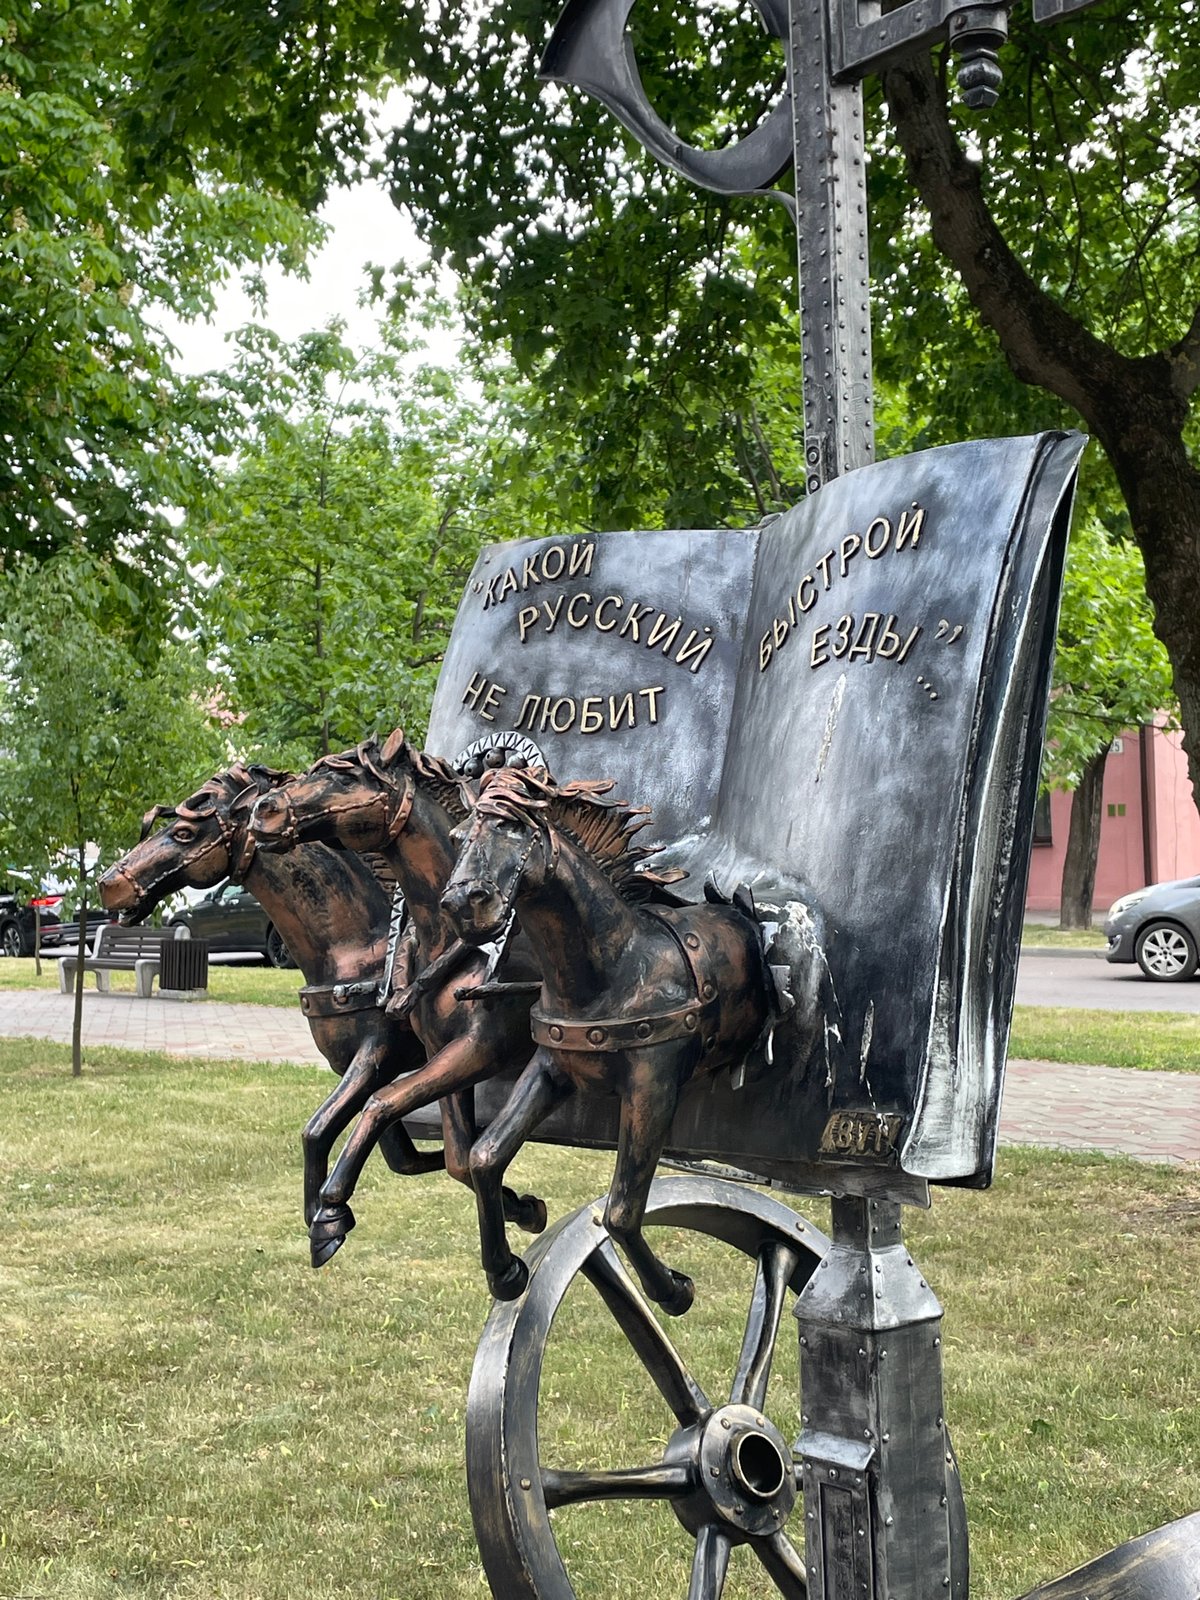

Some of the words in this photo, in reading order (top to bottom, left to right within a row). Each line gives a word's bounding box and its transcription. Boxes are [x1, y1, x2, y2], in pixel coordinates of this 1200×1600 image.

[758, 500, 928, 673] БЫСТРОЙ
[517, 592, 715, 674] РУССКИЙ
[460, 671, 507, 722] НЕ
[513, 685, 666, 734] ЛЮБИТ
